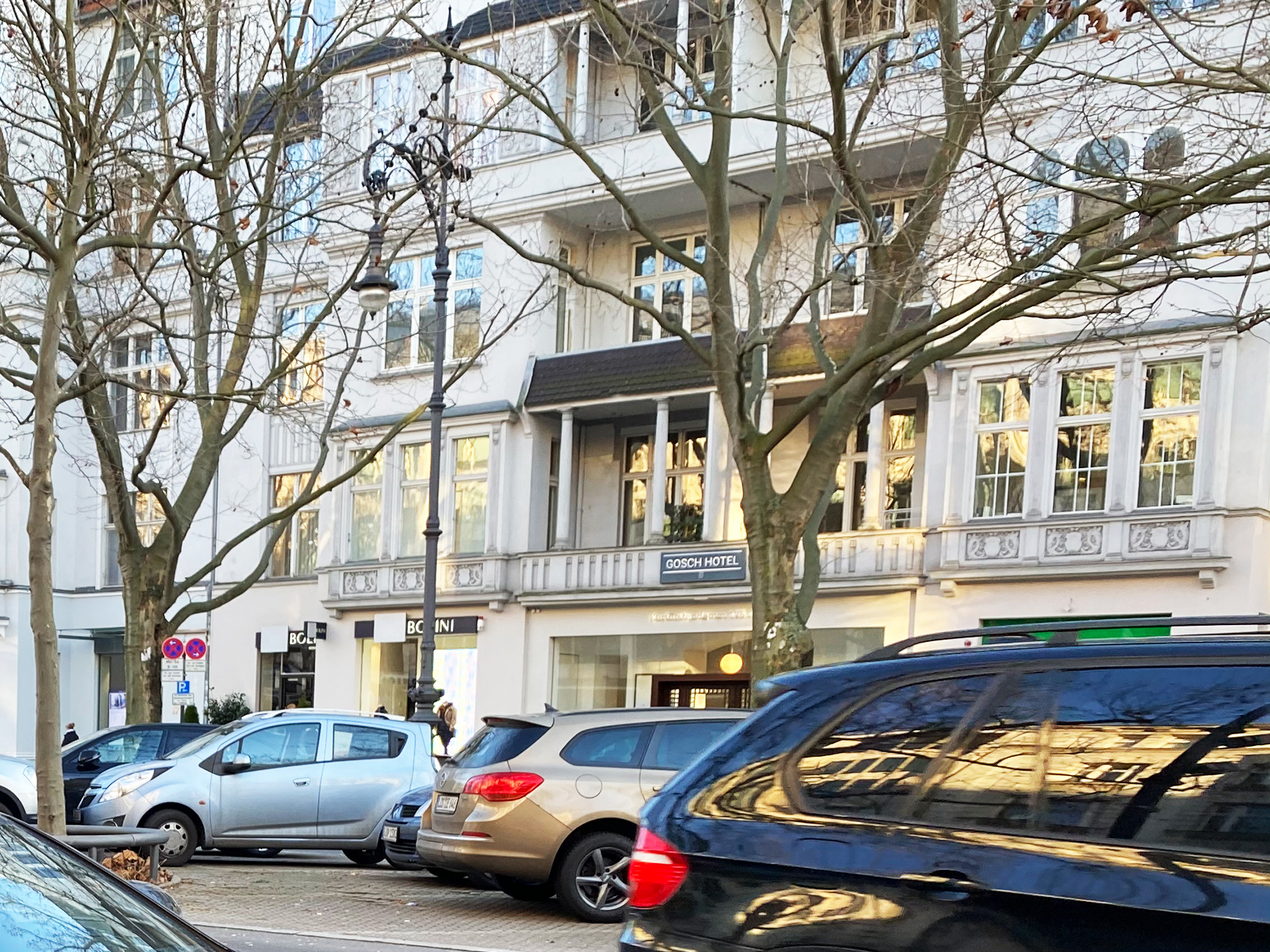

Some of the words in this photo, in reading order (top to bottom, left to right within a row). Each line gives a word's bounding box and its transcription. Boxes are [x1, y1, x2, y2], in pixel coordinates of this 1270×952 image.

[666, 557, 702, 569] GOSCH
[704, 555, 739, 568] HOTEL
[407, 619, 454, 634] BOINI
[178, 682, 186, 693] P
